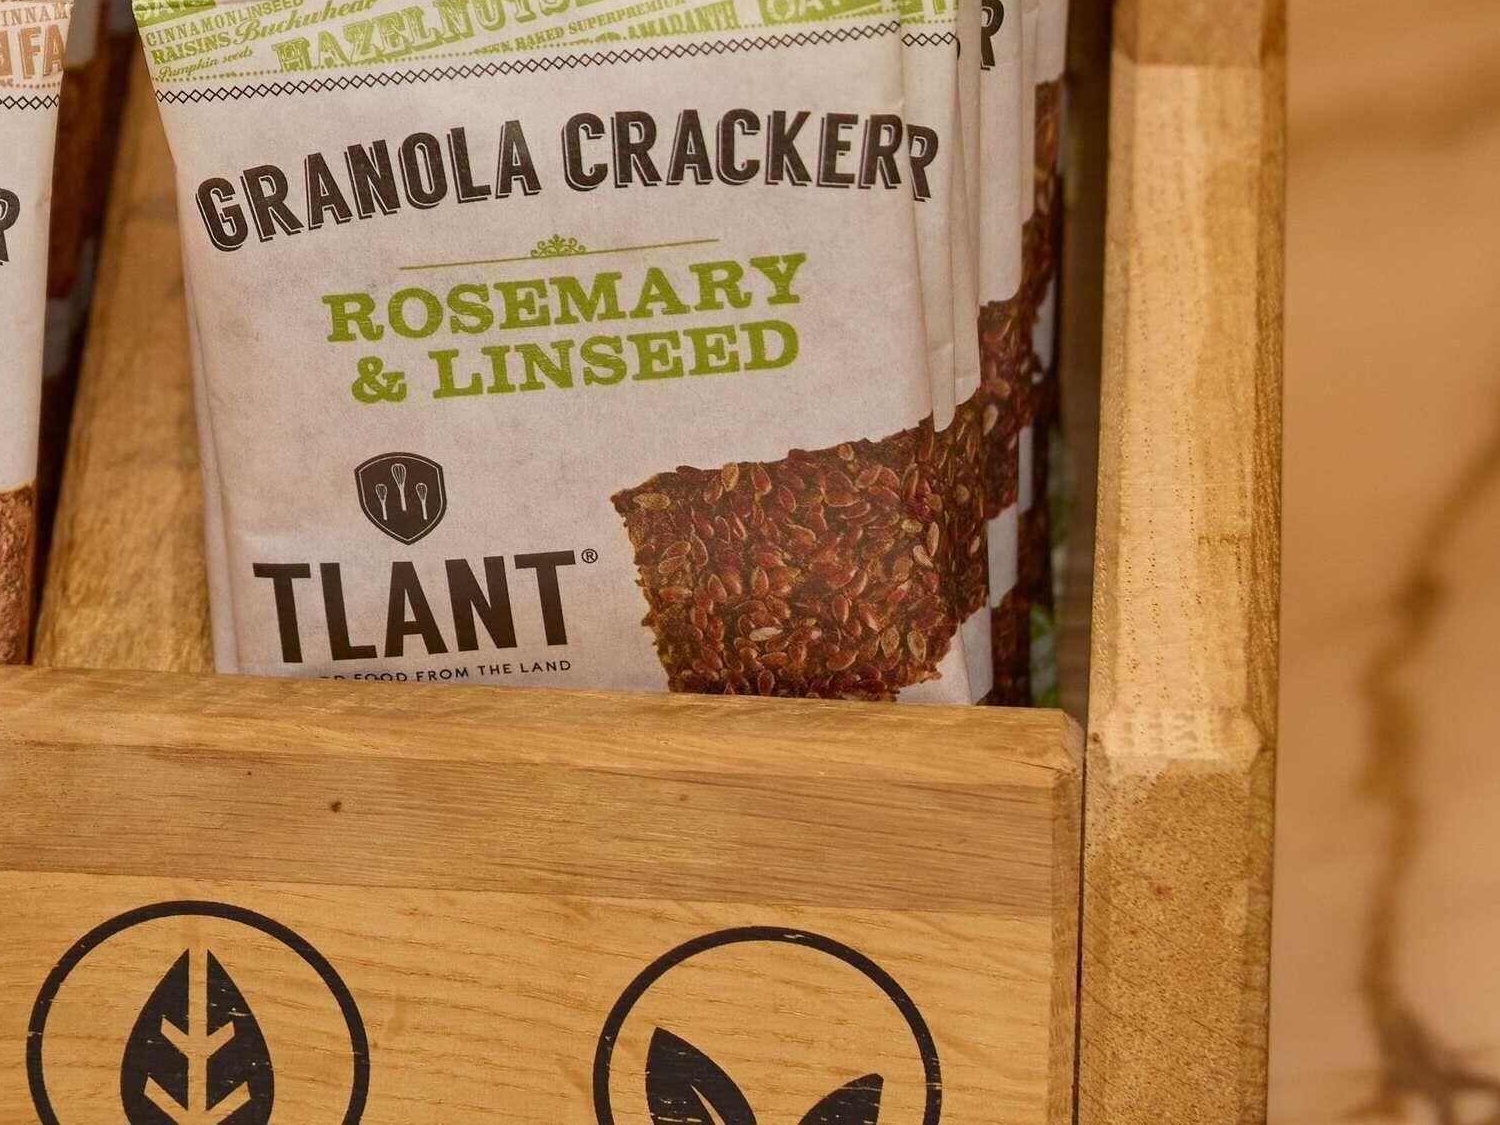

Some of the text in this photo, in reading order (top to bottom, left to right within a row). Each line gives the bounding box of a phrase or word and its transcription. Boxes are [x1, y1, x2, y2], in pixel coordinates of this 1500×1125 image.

[145, 11, 239, 47] CINNAMON
[515, 25, 566, 52] BAKED
[150, 30, 234, 65] RAISINS
[158, 46, 254, 80] Pumpkin seeds
[195, 118, 543, 253] GRANOLA
[559, 108, 903, 195] CRACKER
[322, 251, 809, 345] ROSEMARY
[350, 319, 801, 406] & LINSEED
[416, 666, 469, 683] FROM
[477, 662, 512, 676] THE
[520, 659, 572, 674] LAND
